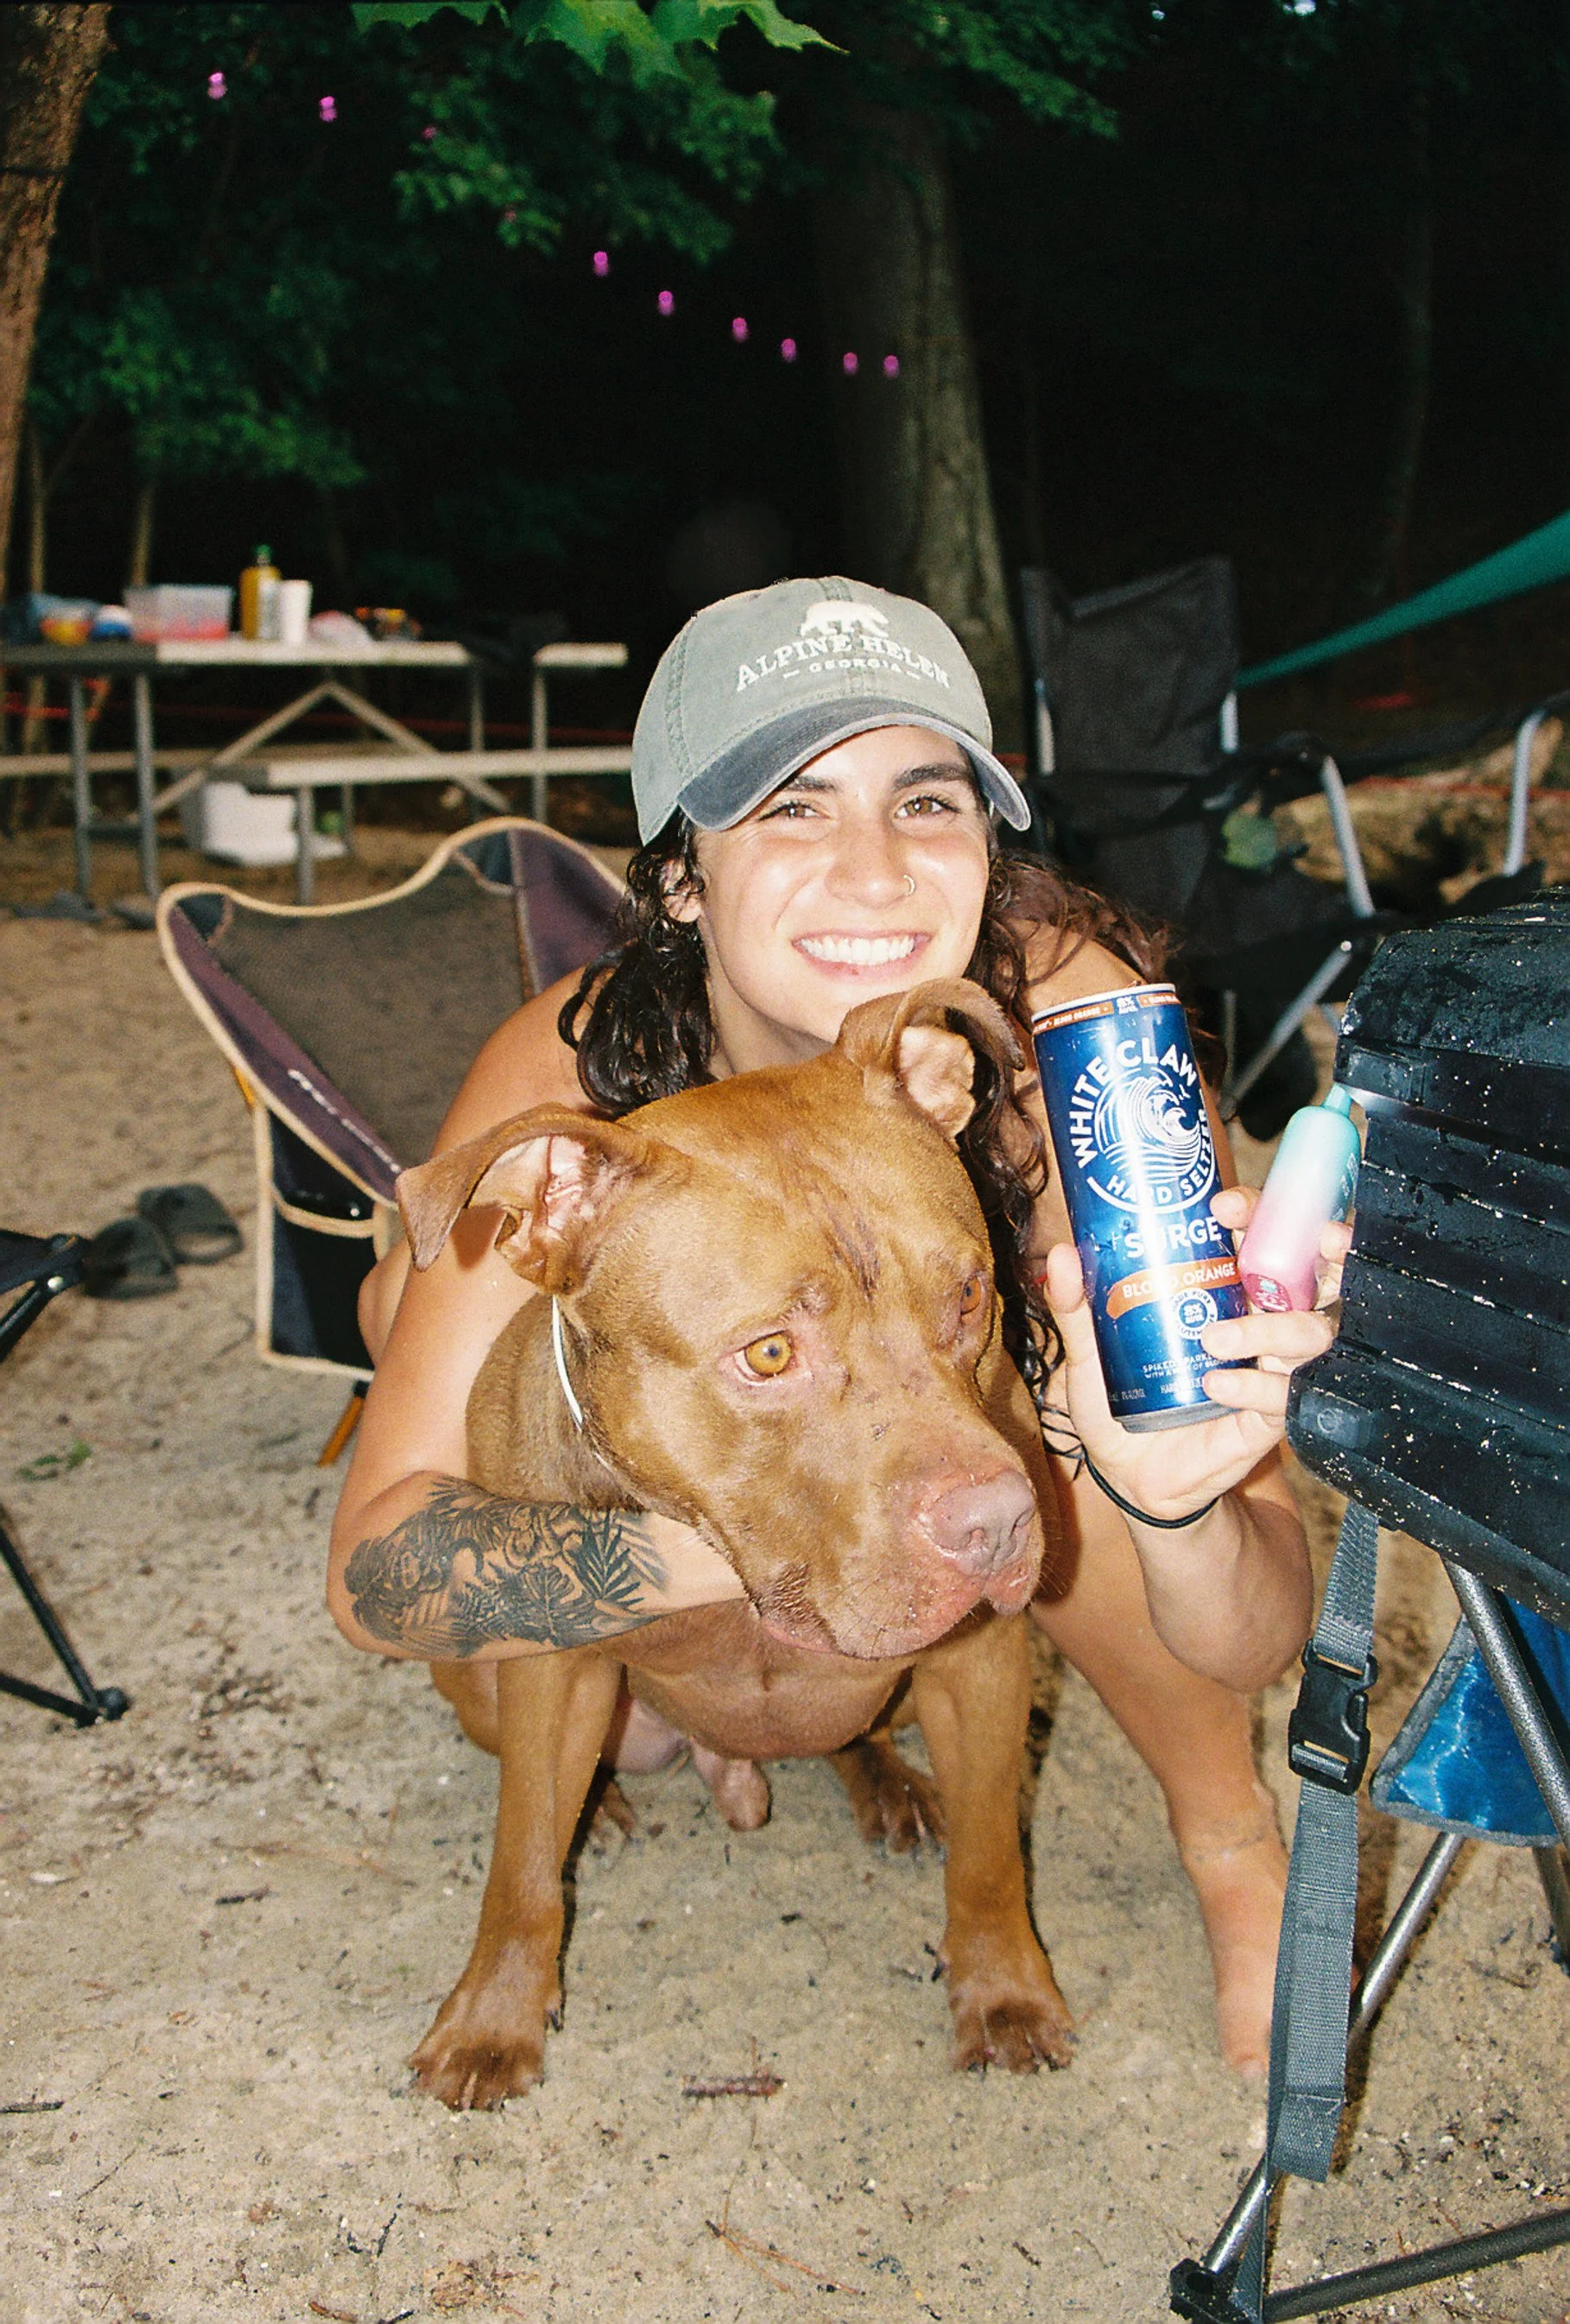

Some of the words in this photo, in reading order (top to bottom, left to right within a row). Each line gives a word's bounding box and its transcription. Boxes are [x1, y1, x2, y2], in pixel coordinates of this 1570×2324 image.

[737, 634, 852, 692] ALPINE
[808, 658, 902, 673] GEORGIA
[1068, 1055, 1117, 1169] WHITE
[1117, 1036, 1198, 1087] CLAW
[1106, 1175, 1173, 1204] HAD
[1124, 1216, 1222, 1258] SURGE
[1123, 1276, 1178, 1299] BLOD
[1182, 1263, 1236, 1286] ORANGE
